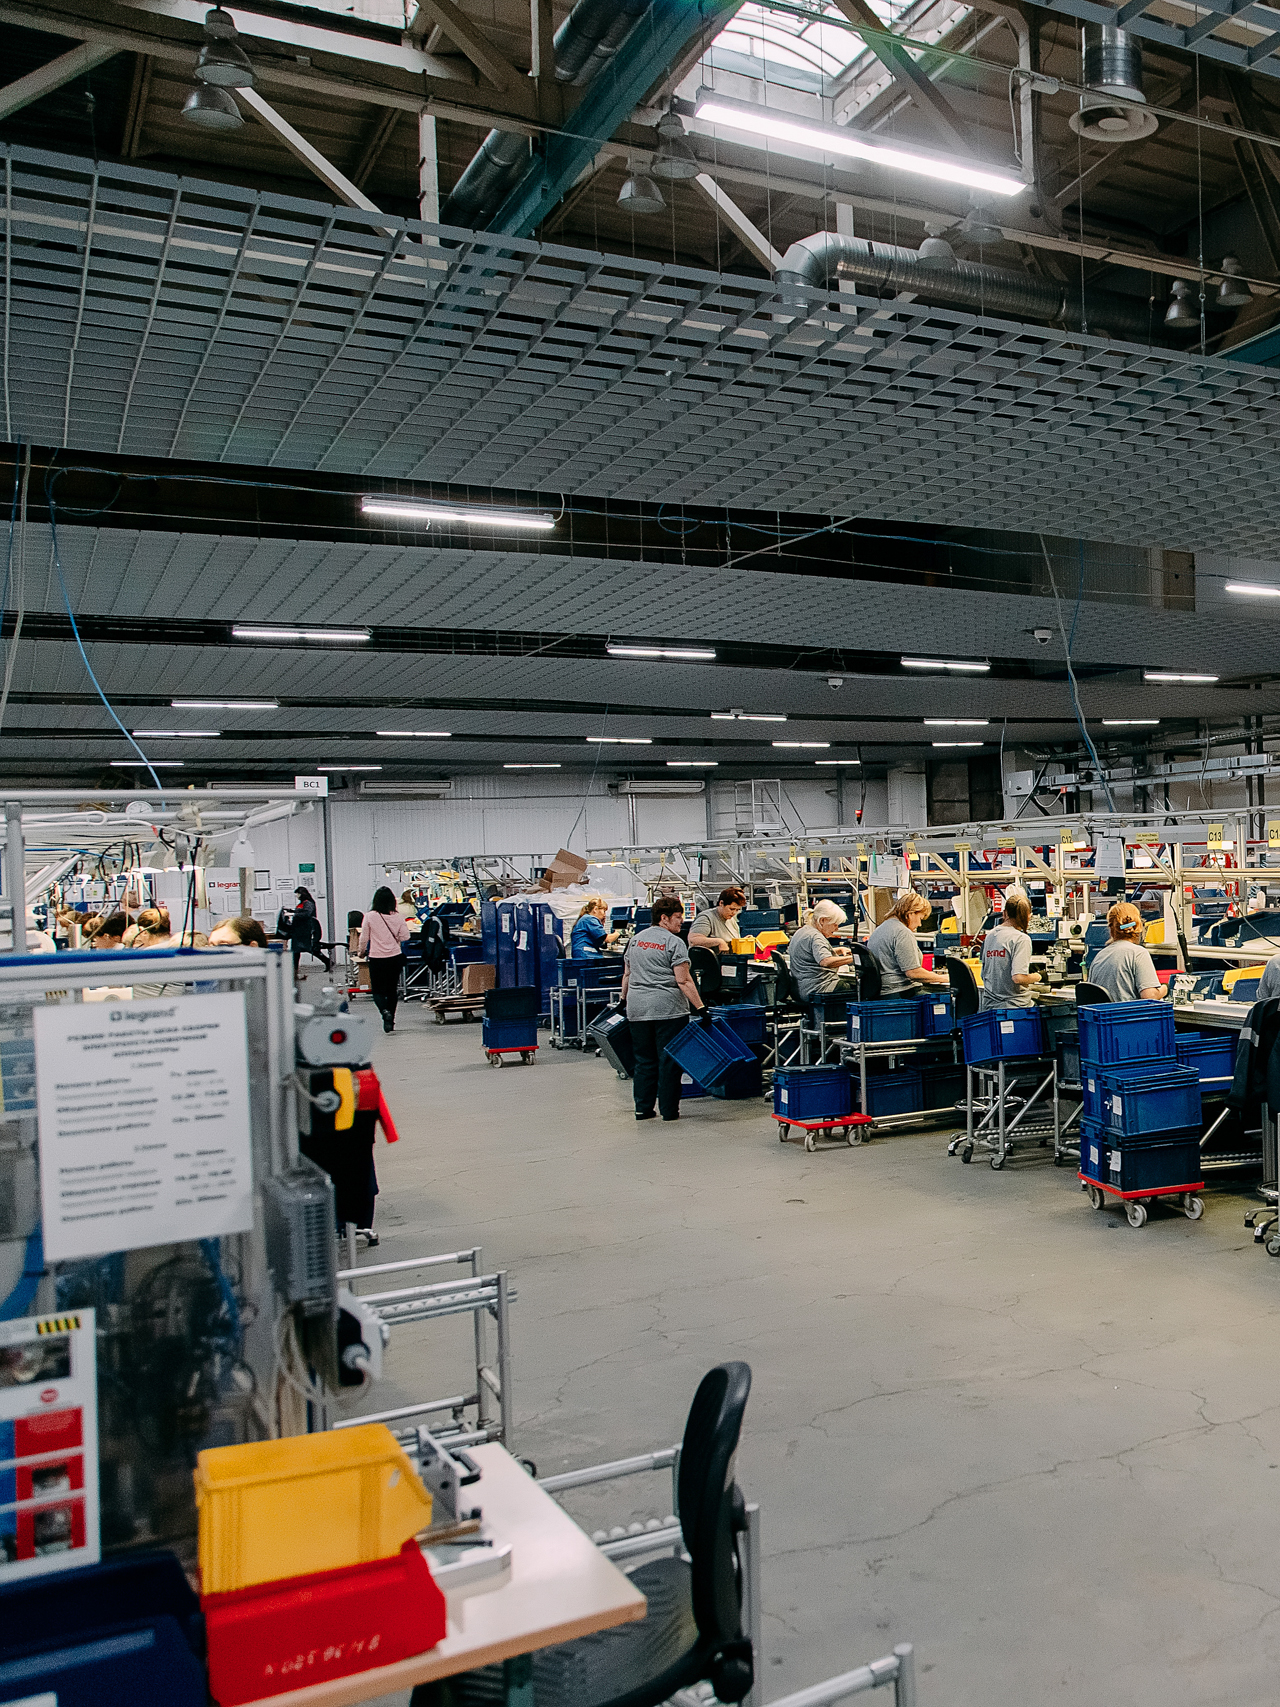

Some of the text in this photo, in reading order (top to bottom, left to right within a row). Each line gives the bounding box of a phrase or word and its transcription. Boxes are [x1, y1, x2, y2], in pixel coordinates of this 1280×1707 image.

[1061, 835, 1073, 844] C12
[1208, 831, 1222, 842] C13
[217, 881, 241, 889] legran
[637, 940, 666, 951] legrand
